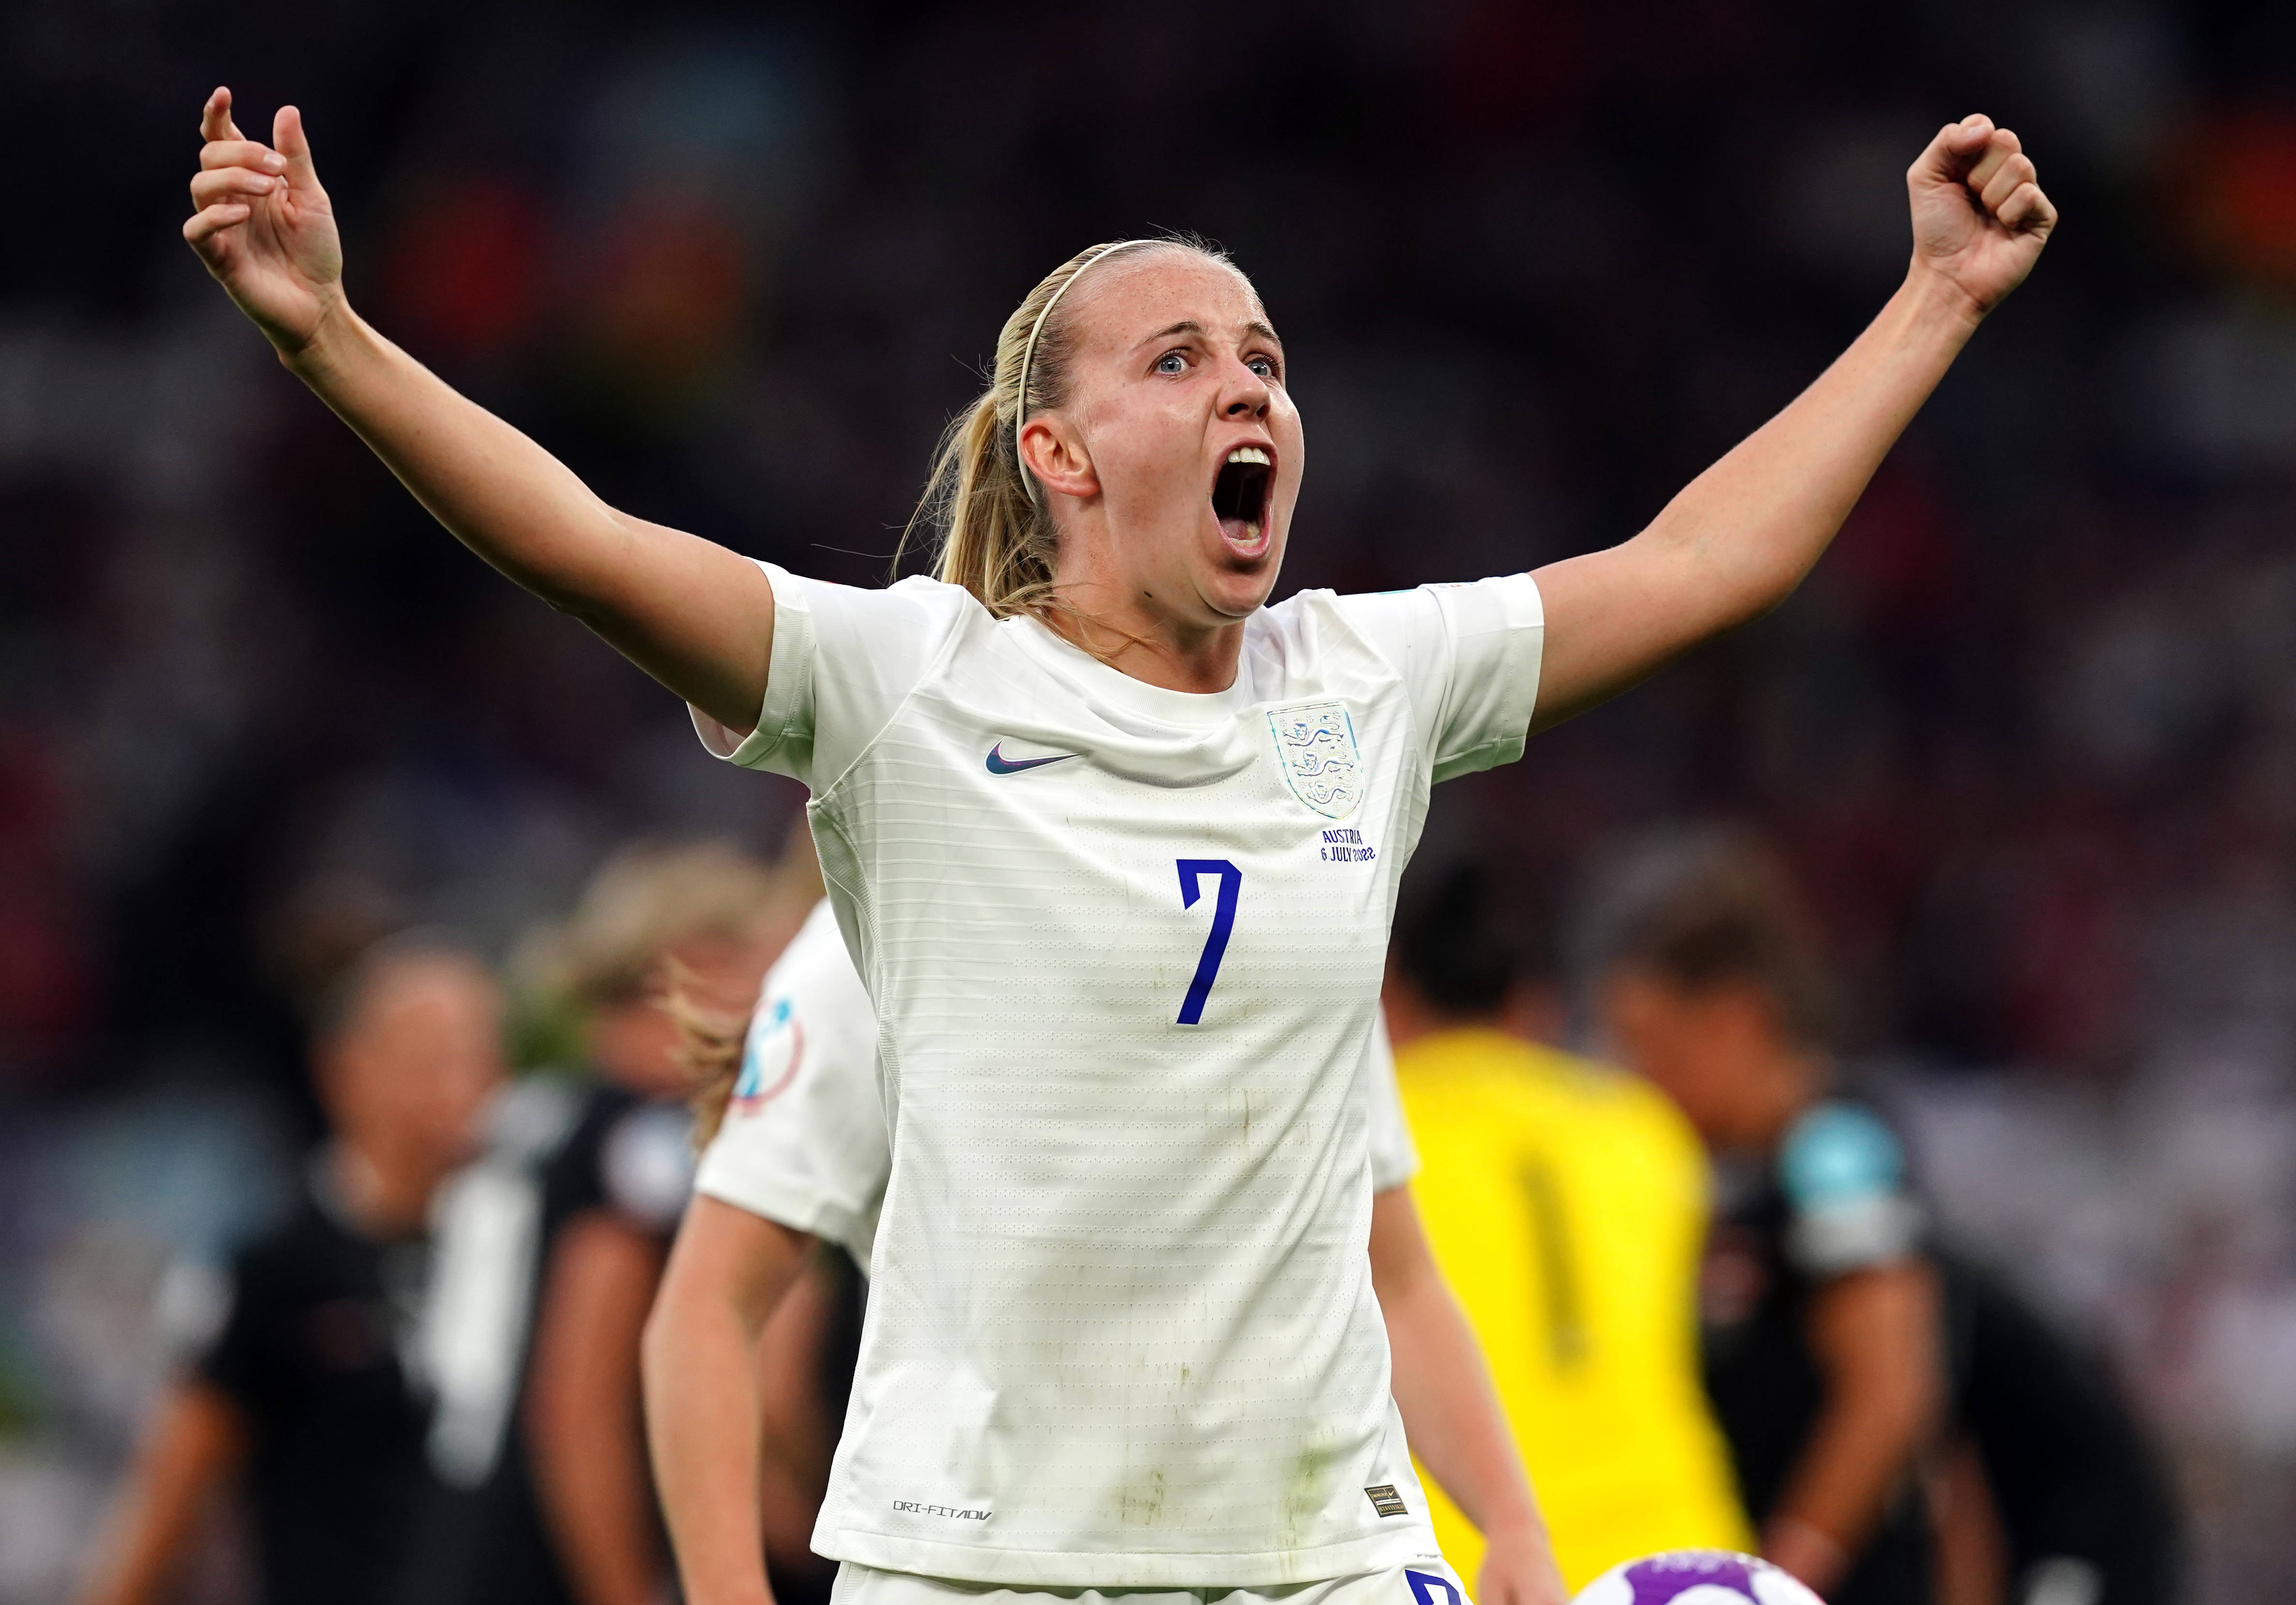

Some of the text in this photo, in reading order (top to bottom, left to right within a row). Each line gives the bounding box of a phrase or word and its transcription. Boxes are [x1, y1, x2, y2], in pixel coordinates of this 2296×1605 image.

[1322, 829, 1363, 845] AUSTRIA
[1321, 847, 1376, 862] 6 JULY 2022
[1176, 859, 1242, 1025] 7
